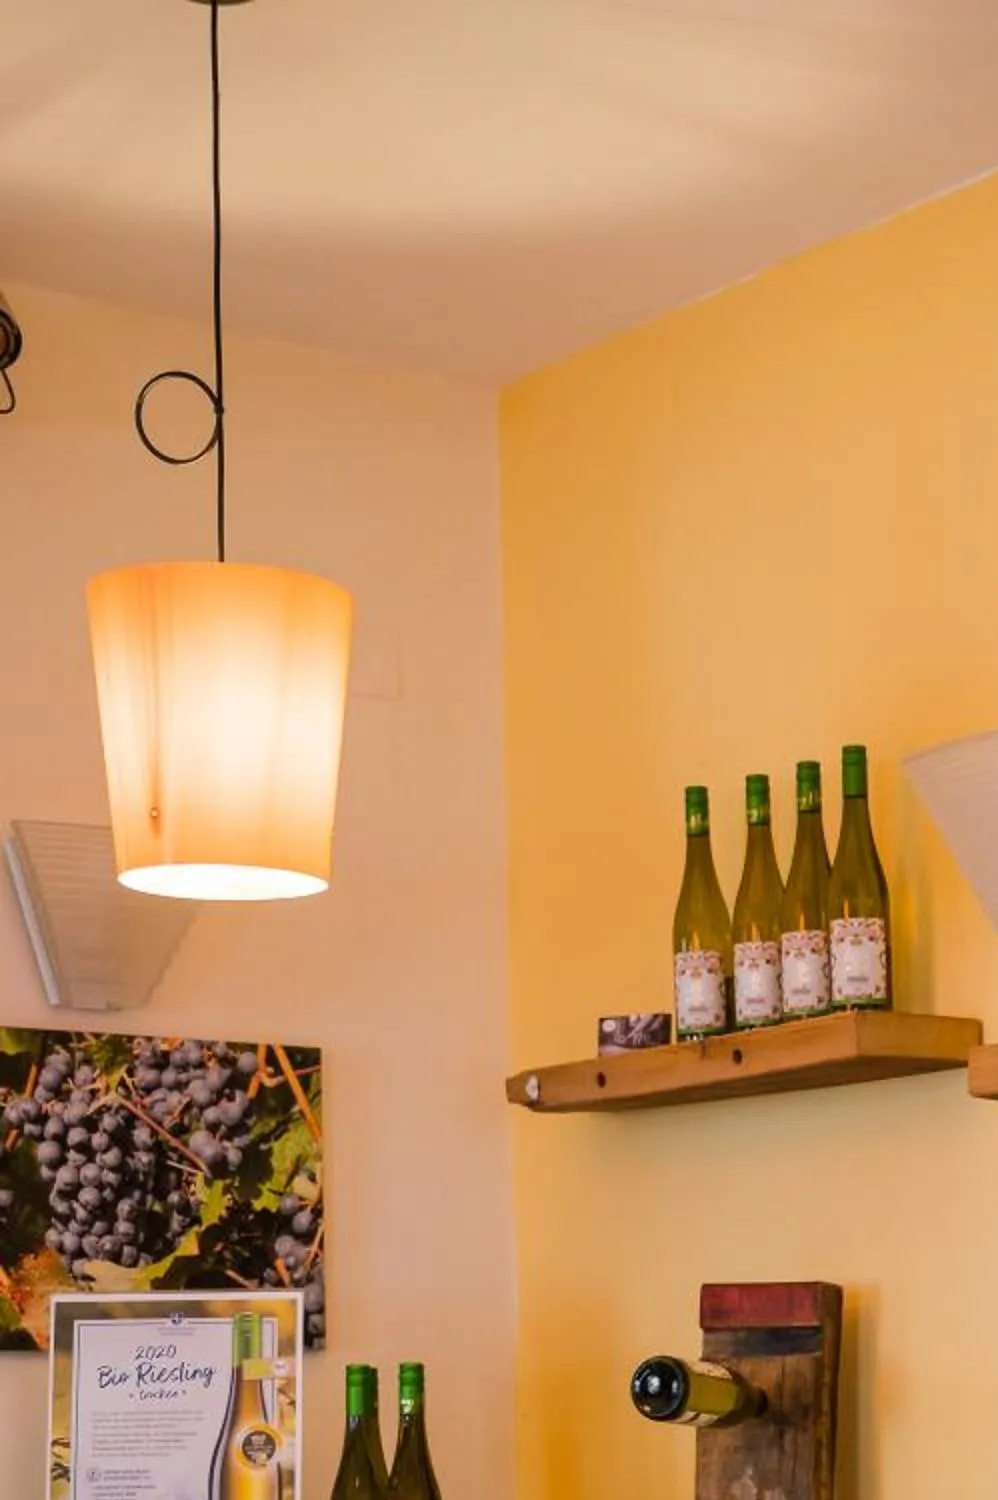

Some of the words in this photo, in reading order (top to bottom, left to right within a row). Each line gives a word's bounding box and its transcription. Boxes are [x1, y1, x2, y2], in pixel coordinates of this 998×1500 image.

[135, 1344, 177, 1360] 2020
[97, 1365, 129, 1389] Bio
[136, 1361, 214, 1389] Riesling
